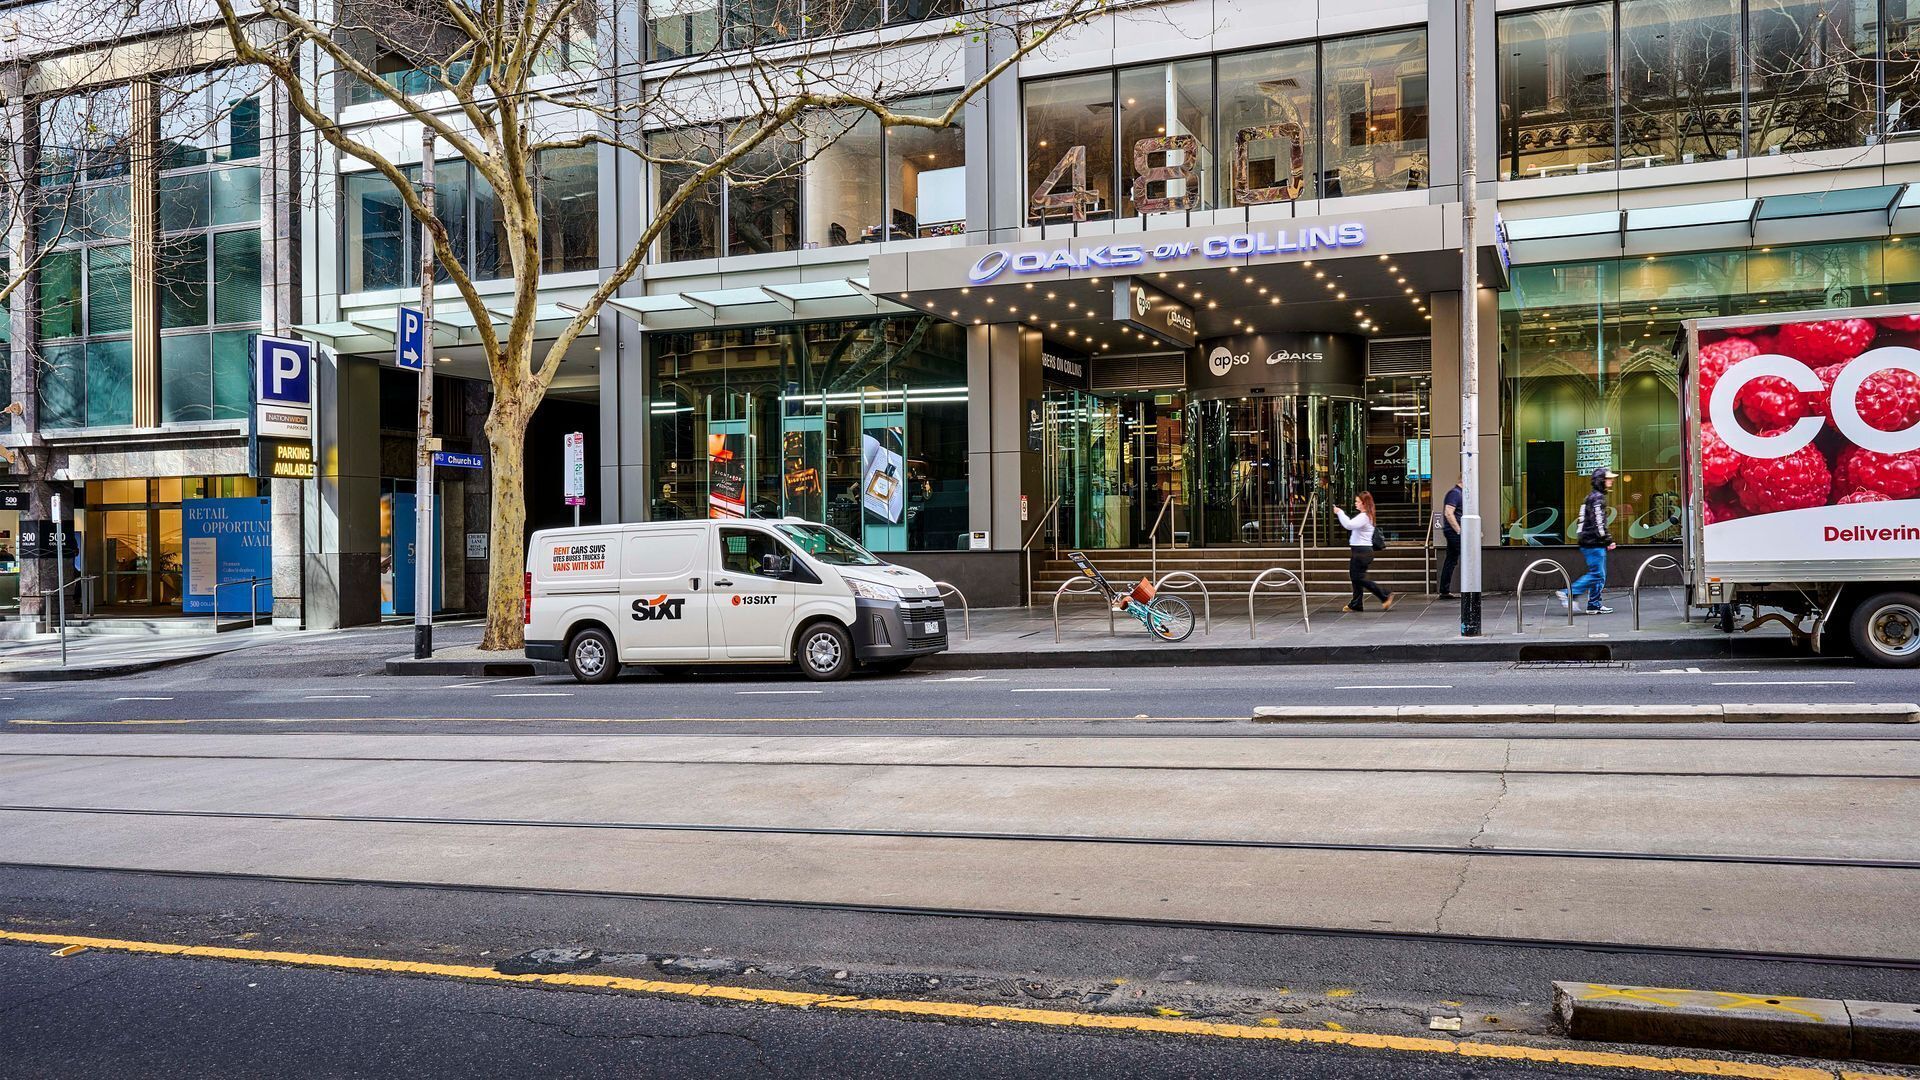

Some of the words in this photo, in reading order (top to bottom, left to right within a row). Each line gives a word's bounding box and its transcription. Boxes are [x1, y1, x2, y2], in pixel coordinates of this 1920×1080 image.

[1032, 122, 1304, 221] 480
[1012, 245, 1143, 271] OAKS
[1203, 223, 1364, 258] COLLINS
[1170, 311, 1191, 329] OAKS
[405, 313, 418, 342] P
[1214, 352, 1250, 369] apso
[1277, 352, 1323, 360] OAKS
[272, 347, 302, 394] P
[1042, 352, 1056, 369] BERS
[1056, 357, 1063, 372] ON
[1064, 360, 1082, 377] COLLINS
[1709, 346, 1920, 459] CO
[268, 413, 305, 423] NATIONWIDE
[277, 445, 310, 460] PARKING
[447, 455, 472, 465] Church
[473, 457, 481, 466] La
[274, 462, 314, 476] AVAILABLE
[5, 496, 17, 504] 500
[189, 507, 229, 520] RETAIL
[202, 520, 272, 534] OPPORTUNI
[1824, 524, 1920, 542] Deliverin
[22, 532, 35, 542] 500
[241, 535, 272, 548] AVAIL
[554, 546, 570, 555] RENT
[571, 545, 588, 554] CARS
[589, 544, 606, 553] SUVS
[553, 563, 570, 571] VANS
[572, 562, 588, 570] WITH
[590, 561, 605, 570] SIXT
